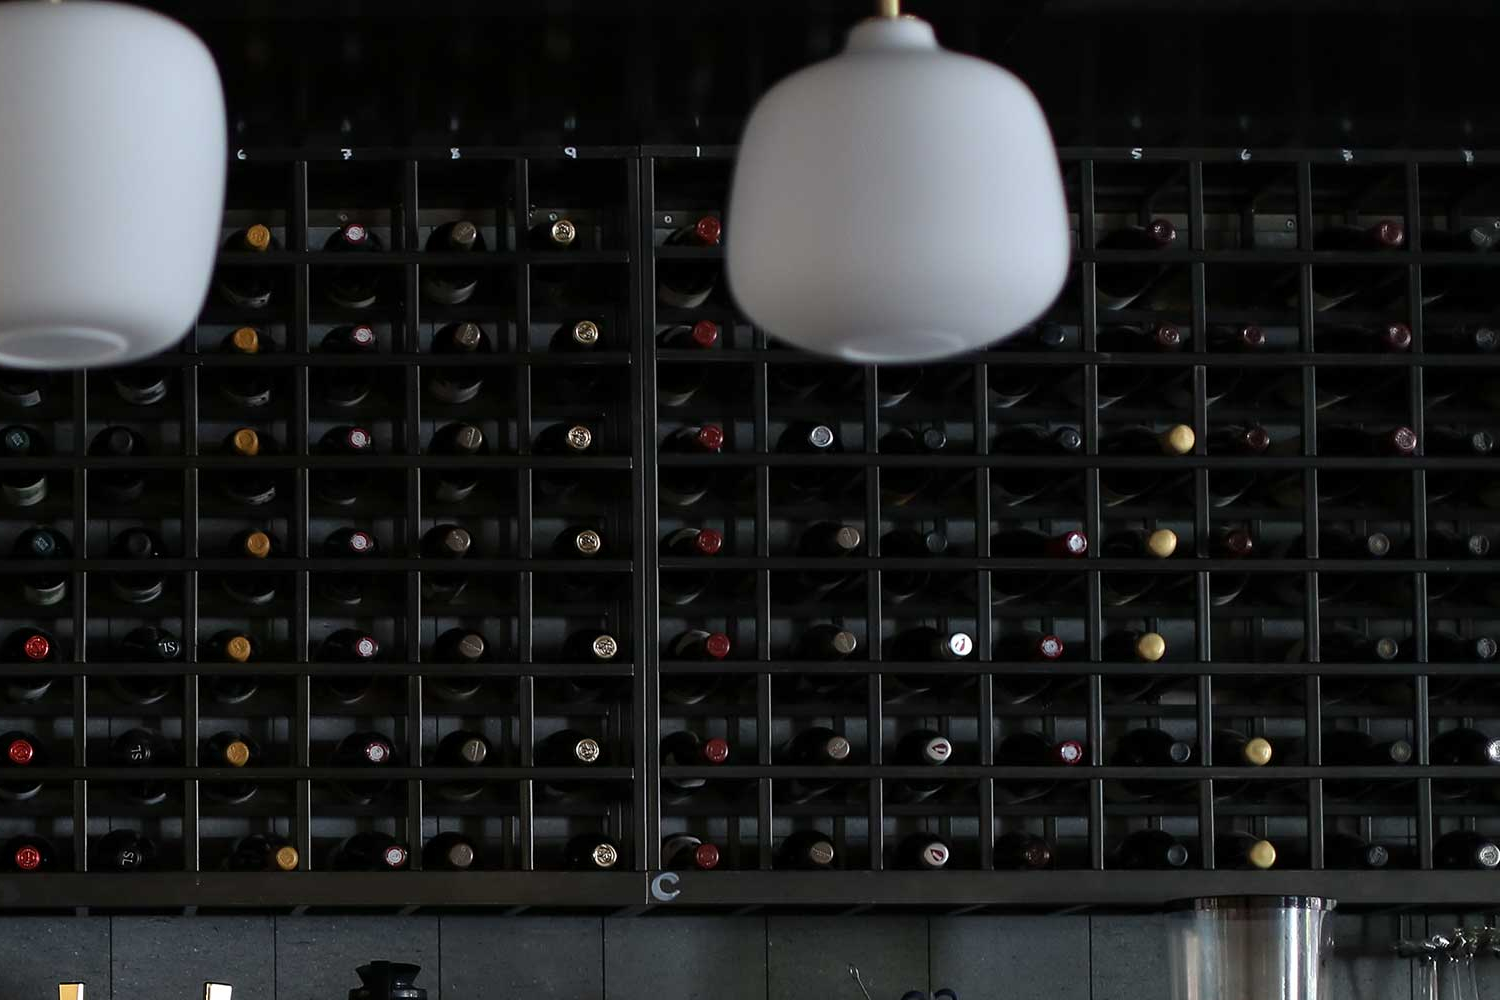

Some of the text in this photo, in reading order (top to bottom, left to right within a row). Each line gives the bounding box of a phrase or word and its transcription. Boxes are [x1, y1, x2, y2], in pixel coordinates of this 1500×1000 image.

[236, 149, 247, 160] 6
[564, 147, 577, 159] 9
[1131, 148, 1143, 160] 5
[1241, 148, 1252, 160] 6
[651, 871, 681, 902] C
